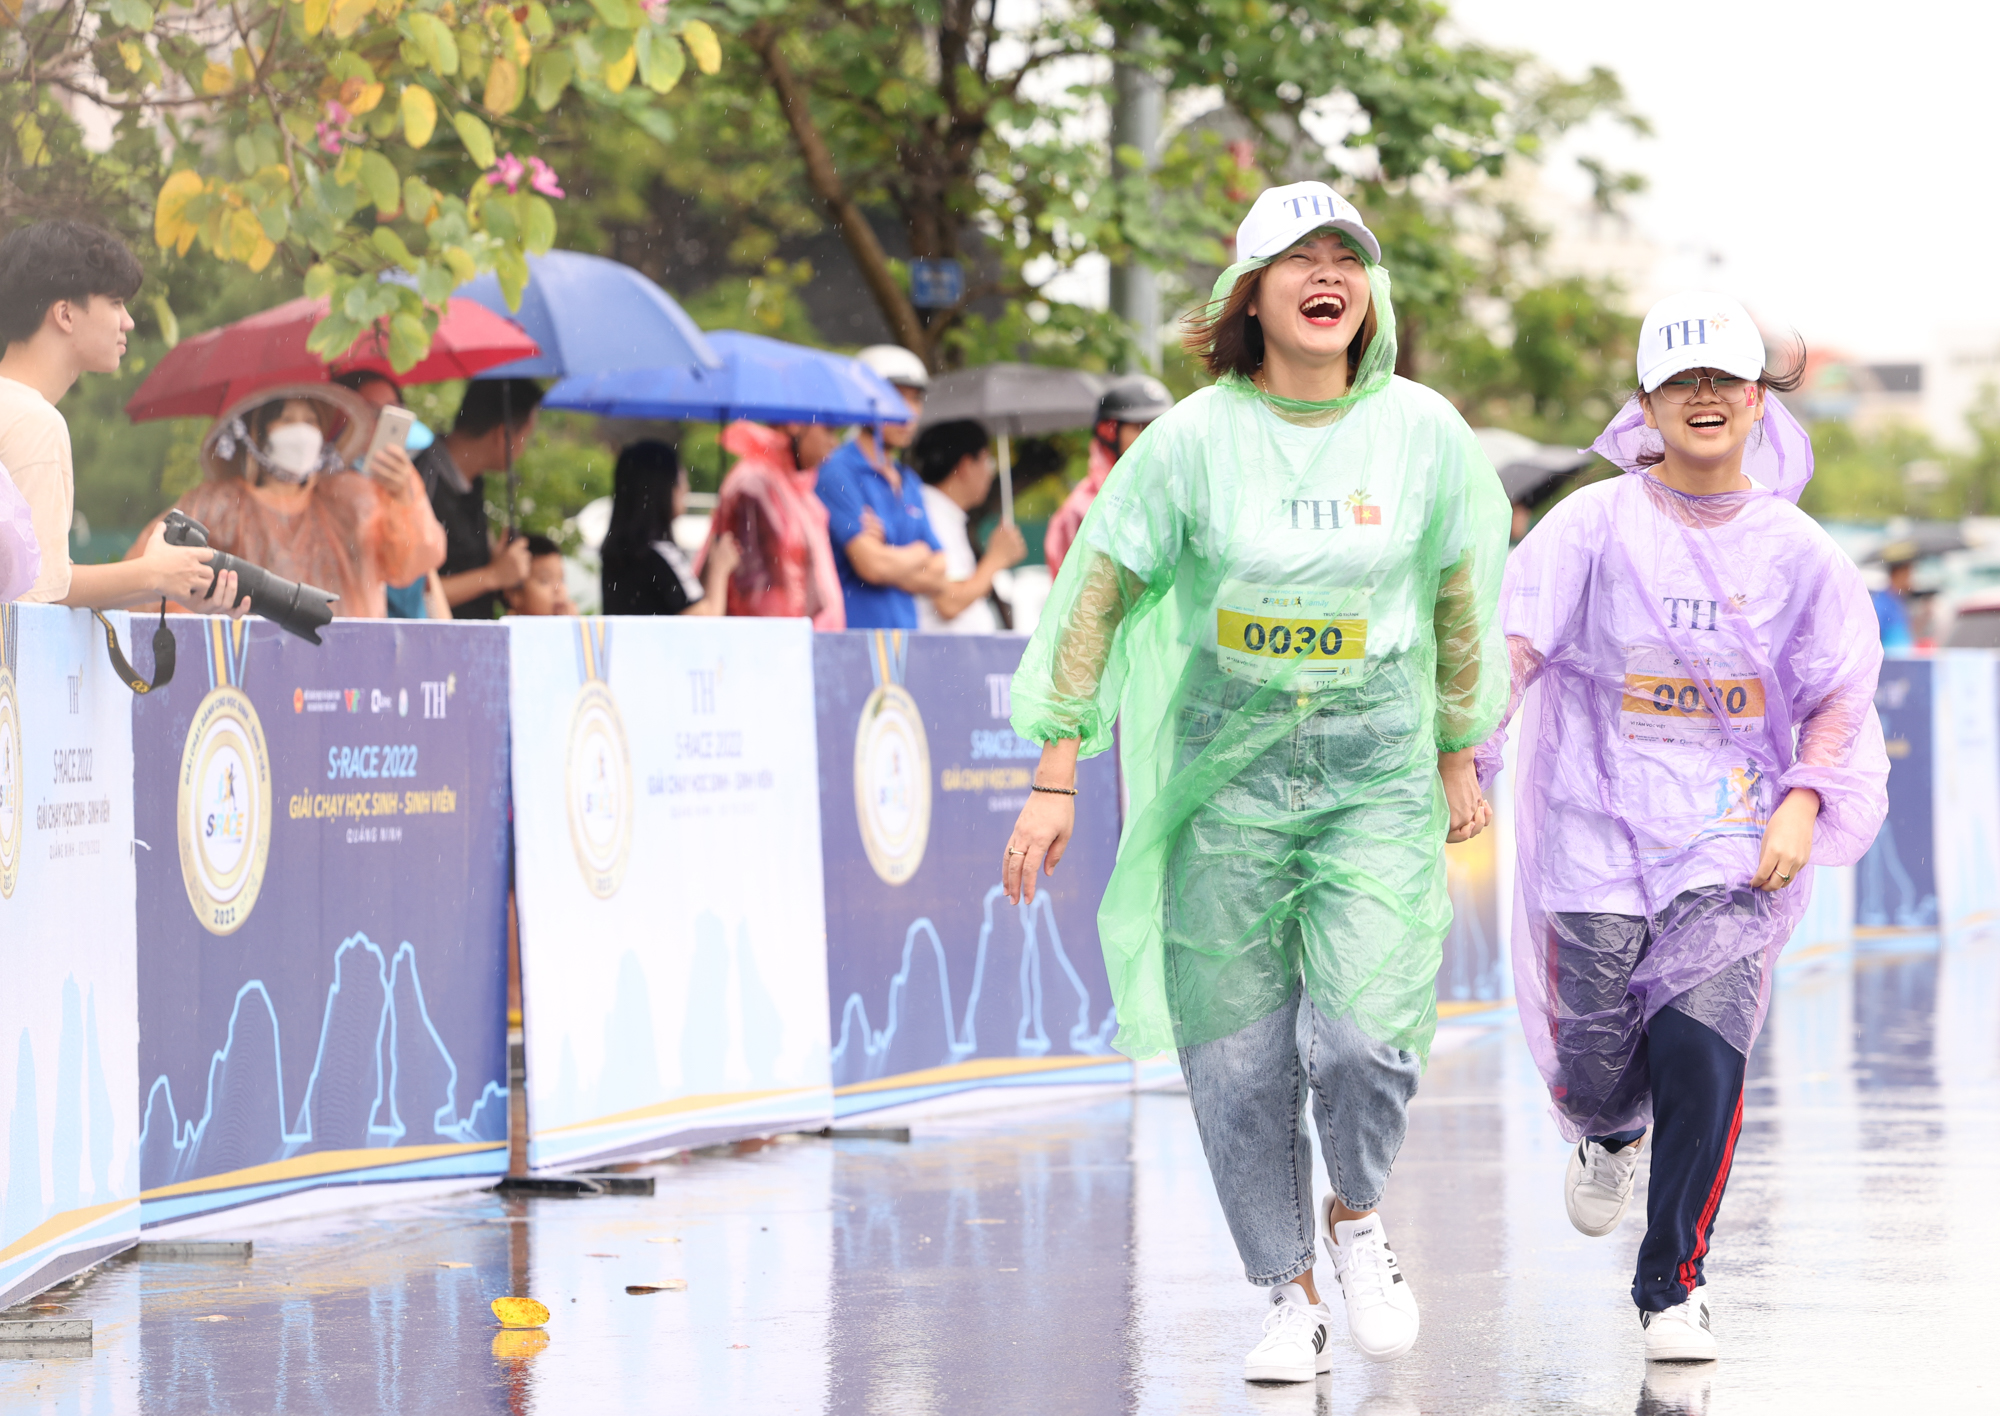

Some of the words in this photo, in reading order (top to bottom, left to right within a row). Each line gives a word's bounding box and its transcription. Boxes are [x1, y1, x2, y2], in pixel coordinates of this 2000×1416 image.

[1283, 195, 1335, 219] TH
[1659, 319, 1708, 351] TH
[1282, 499, 1343, 530] TH
[1663, 597, 1720, 631] TH
[1244, 622, 1343, 656] 0030
[67, 676, 79, 714] TH
[420, 681, 446, 719] TH
[77, 748, 93, 782] 2022
[381, 744, 418, 778] 2022
[37, 796, 48, 830] GIẢI
[48, 803, 62, 835] CHẠY
[62, 802, 74, 835] HỌC
[74, 801, 85, 826] SINH
[88, 800, 99, 825] SINH
[289, 787, 313, 819] GIẢI
[314, 793, 345, 823] CHẠY
[345, 792, 371, 822] HỌC
[371, 791, 399, 816] SINH
[404, 790, 431, 815] SINH
[431, 785, 457, 813] VIÊN
[346, 825, 377, 843] QUẢNG
[379, 826, 402, 842] NINH
[214, 907, 235, 925] 2022
